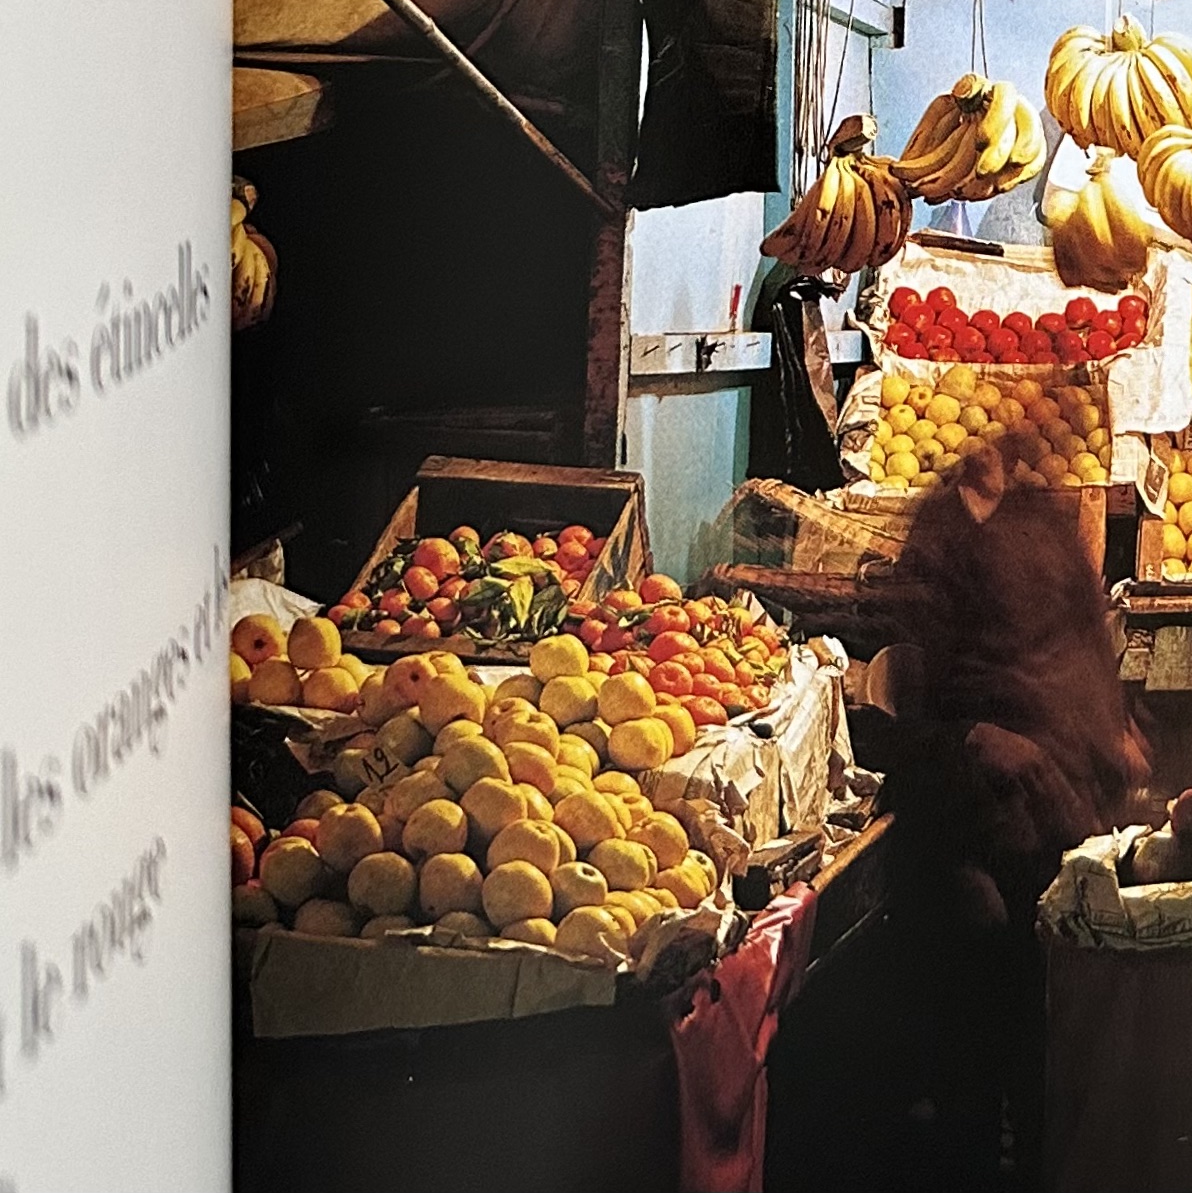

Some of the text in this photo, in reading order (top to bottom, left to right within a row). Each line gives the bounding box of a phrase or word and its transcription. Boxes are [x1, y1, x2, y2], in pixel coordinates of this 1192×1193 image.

[7, 310, 80, 437] des
[72, 624, 190, 794] oranges
[361, 748, 399, 784] 12
[72, 835, 168, 1001] rouge
